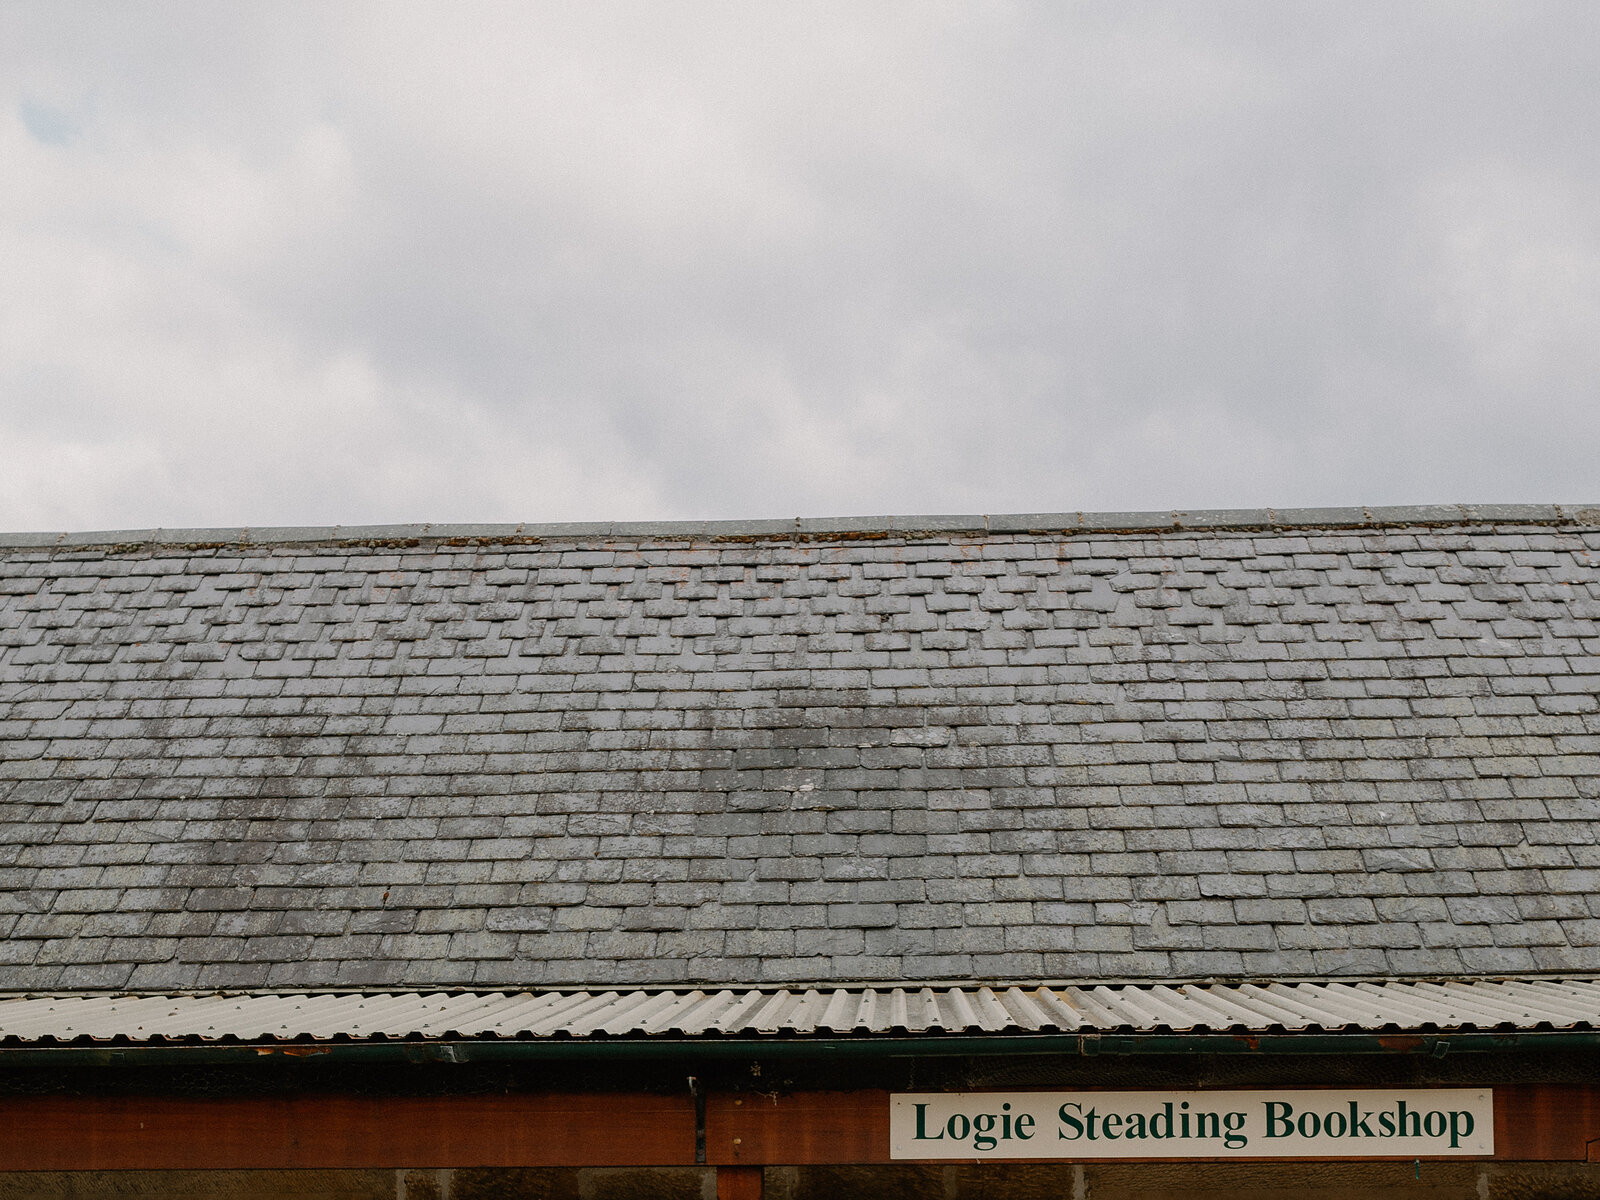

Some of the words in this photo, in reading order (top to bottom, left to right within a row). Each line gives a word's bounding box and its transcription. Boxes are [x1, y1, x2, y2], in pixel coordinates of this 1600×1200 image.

[912, 1103, 1035, 1150] Logie
[1058, 1101, 1248, 1150] Steading
[1262, 1100, 1475, 1148] Bookshop
